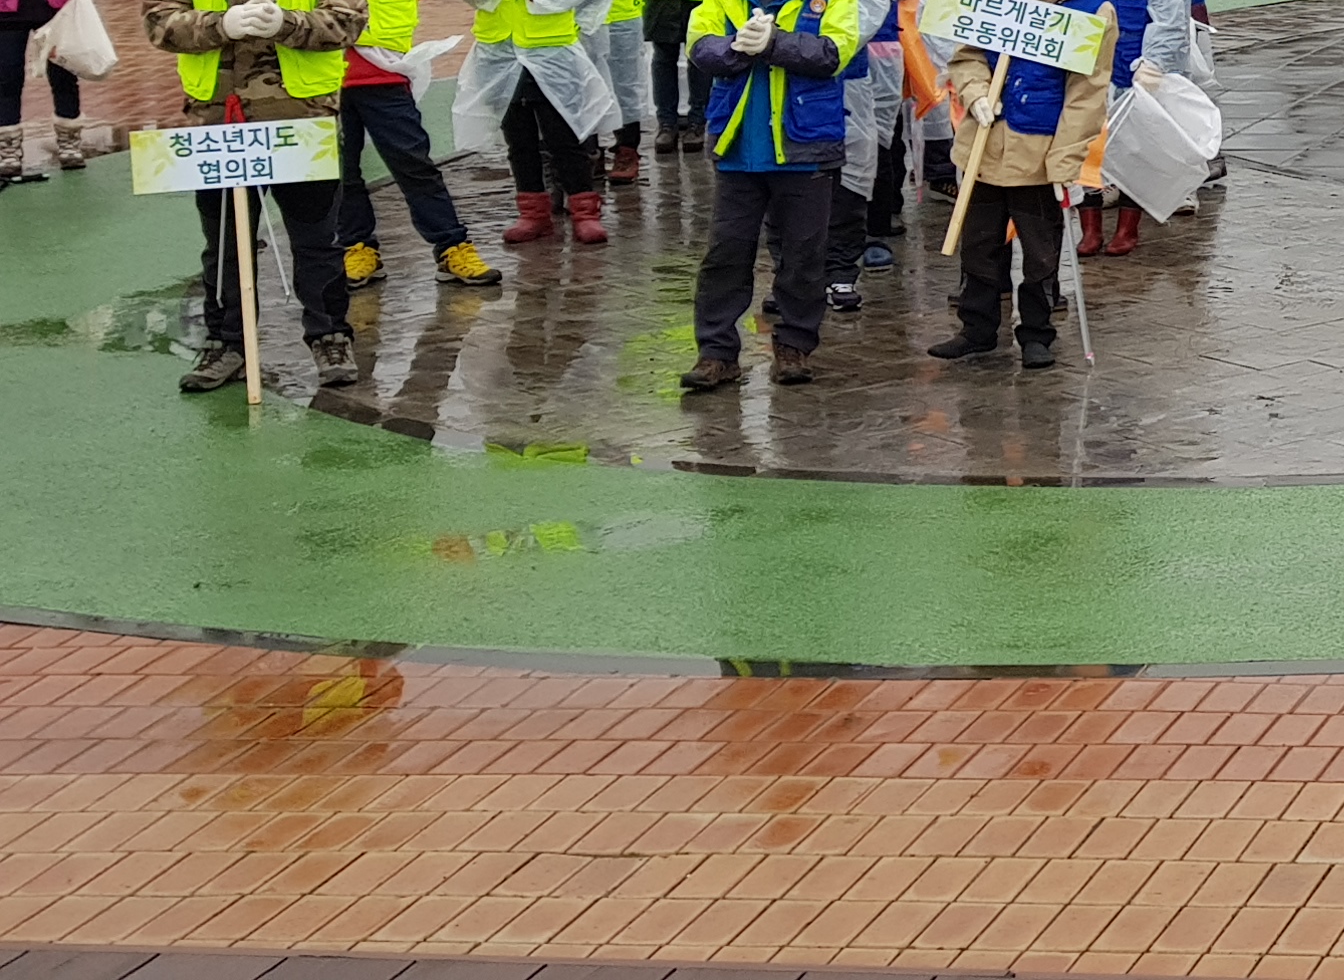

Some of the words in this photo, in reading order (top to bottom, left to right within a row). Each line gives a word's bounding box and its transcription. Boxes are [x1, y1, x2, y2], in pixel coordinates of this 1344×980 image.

[952, 15, 1064, 63] 운동위원회
[169, 126, 299, 158] 청소년지도
[197, 155, 274, 185] 협의회
